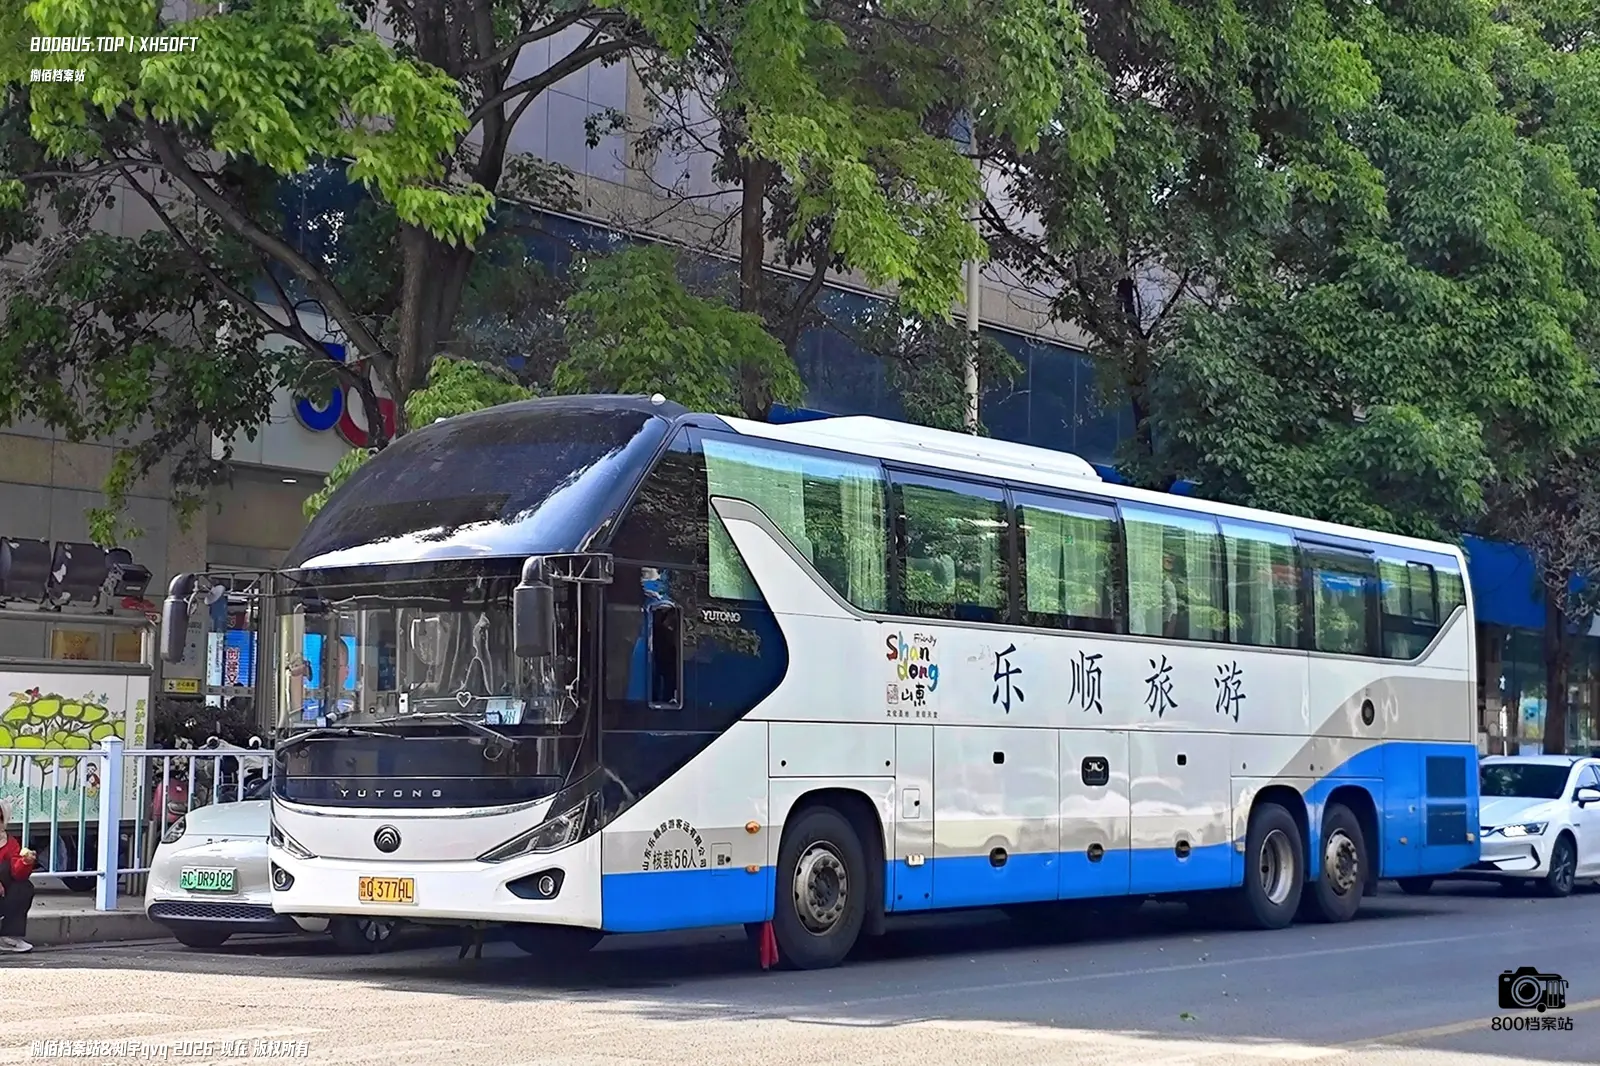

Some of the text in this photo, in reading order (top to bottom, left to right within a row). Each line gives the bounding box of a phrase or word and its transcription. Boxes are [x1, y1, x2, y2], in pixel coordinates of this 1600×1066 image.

[702, 609, 741, 622] YUTONG
[886, 631, 930, 661] Shan
[897, 658, 938, 692] dong
[992, 643, 1247, 723] 乐顺旅游
[340, 789, 442, 798] YUTONG
[652, 848, 697, 870] 核载56人
